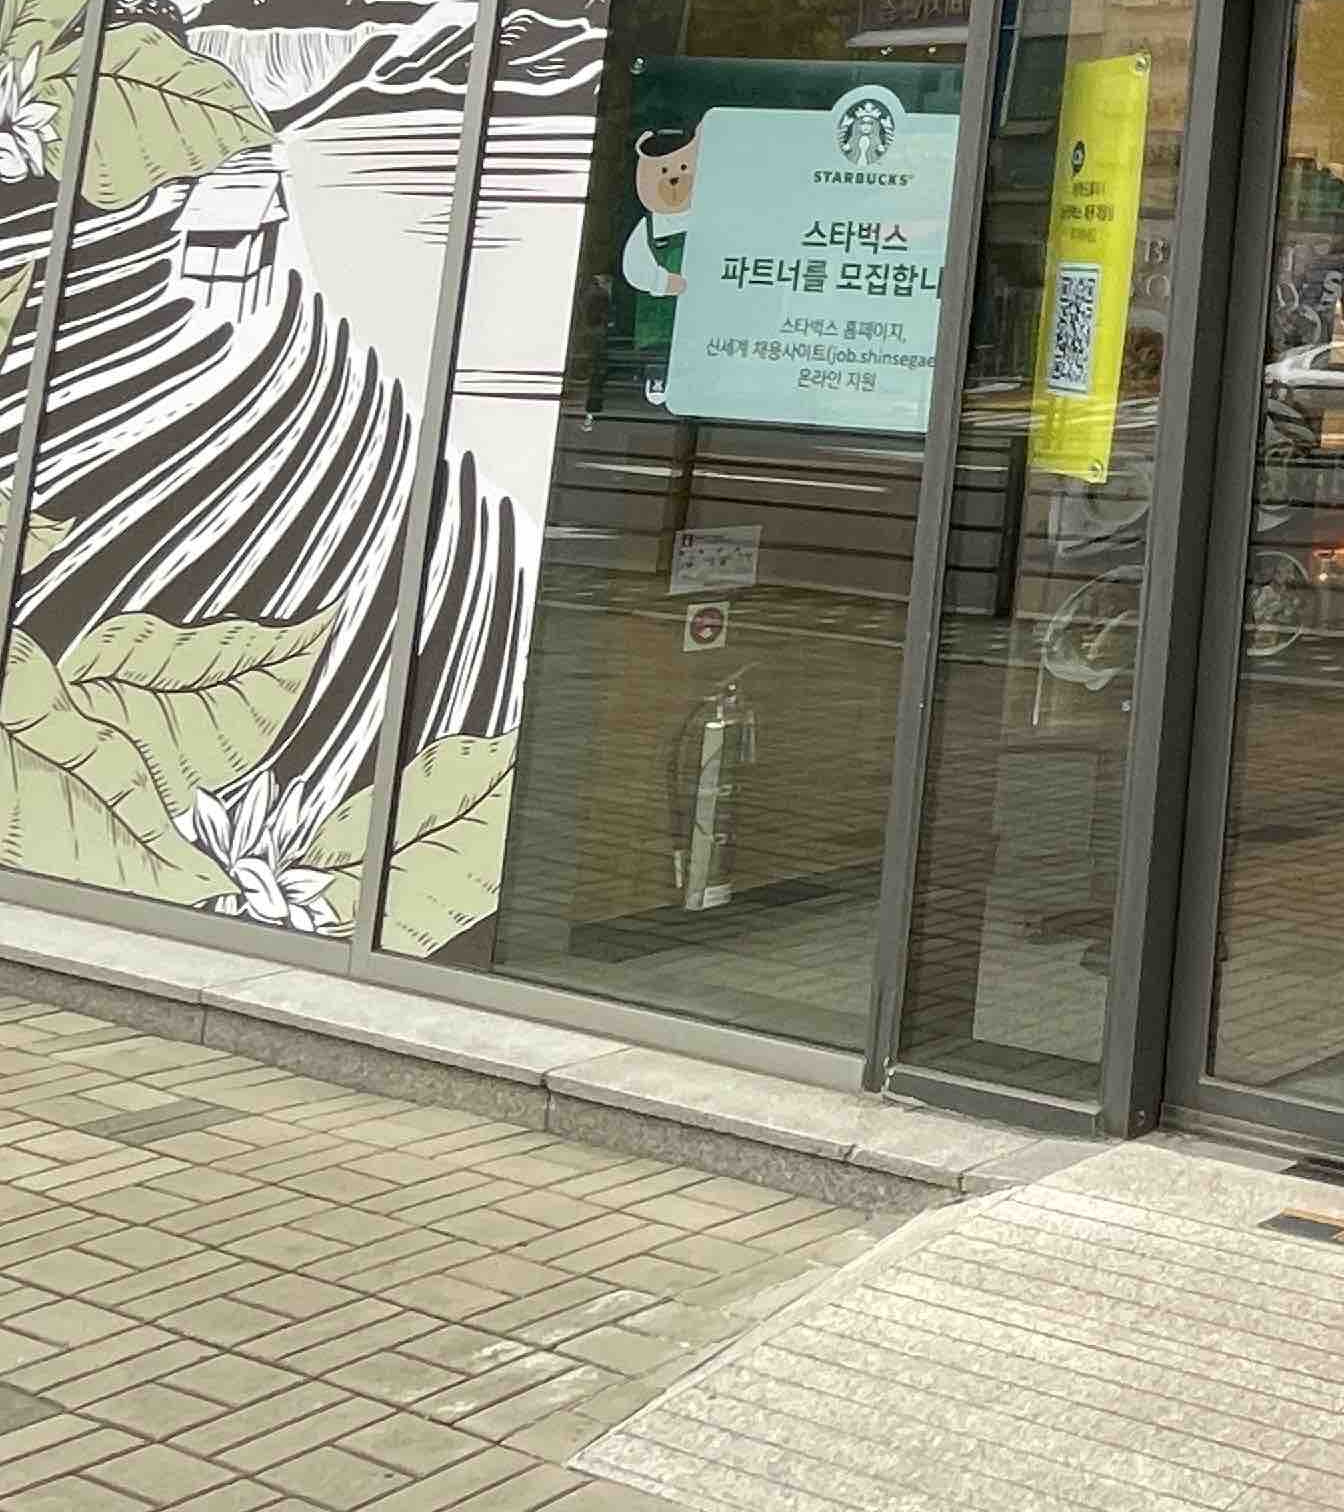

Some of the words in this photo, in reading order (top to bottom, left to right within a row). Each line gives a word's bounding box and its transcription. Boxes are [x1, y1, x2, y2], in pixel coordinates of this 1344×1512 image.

[813, 170, 909, 186] STARBUCKS
[801, 220, 908, 255] 스타벅스
[720, 256, 828, 293] 파트너를
[779, 316, 839, 337] 스타벅스
[706, 337, 749, 358] 신세계
[797, 368, 842, 389] 온라인
[846, 371, 876, 392] 지원
